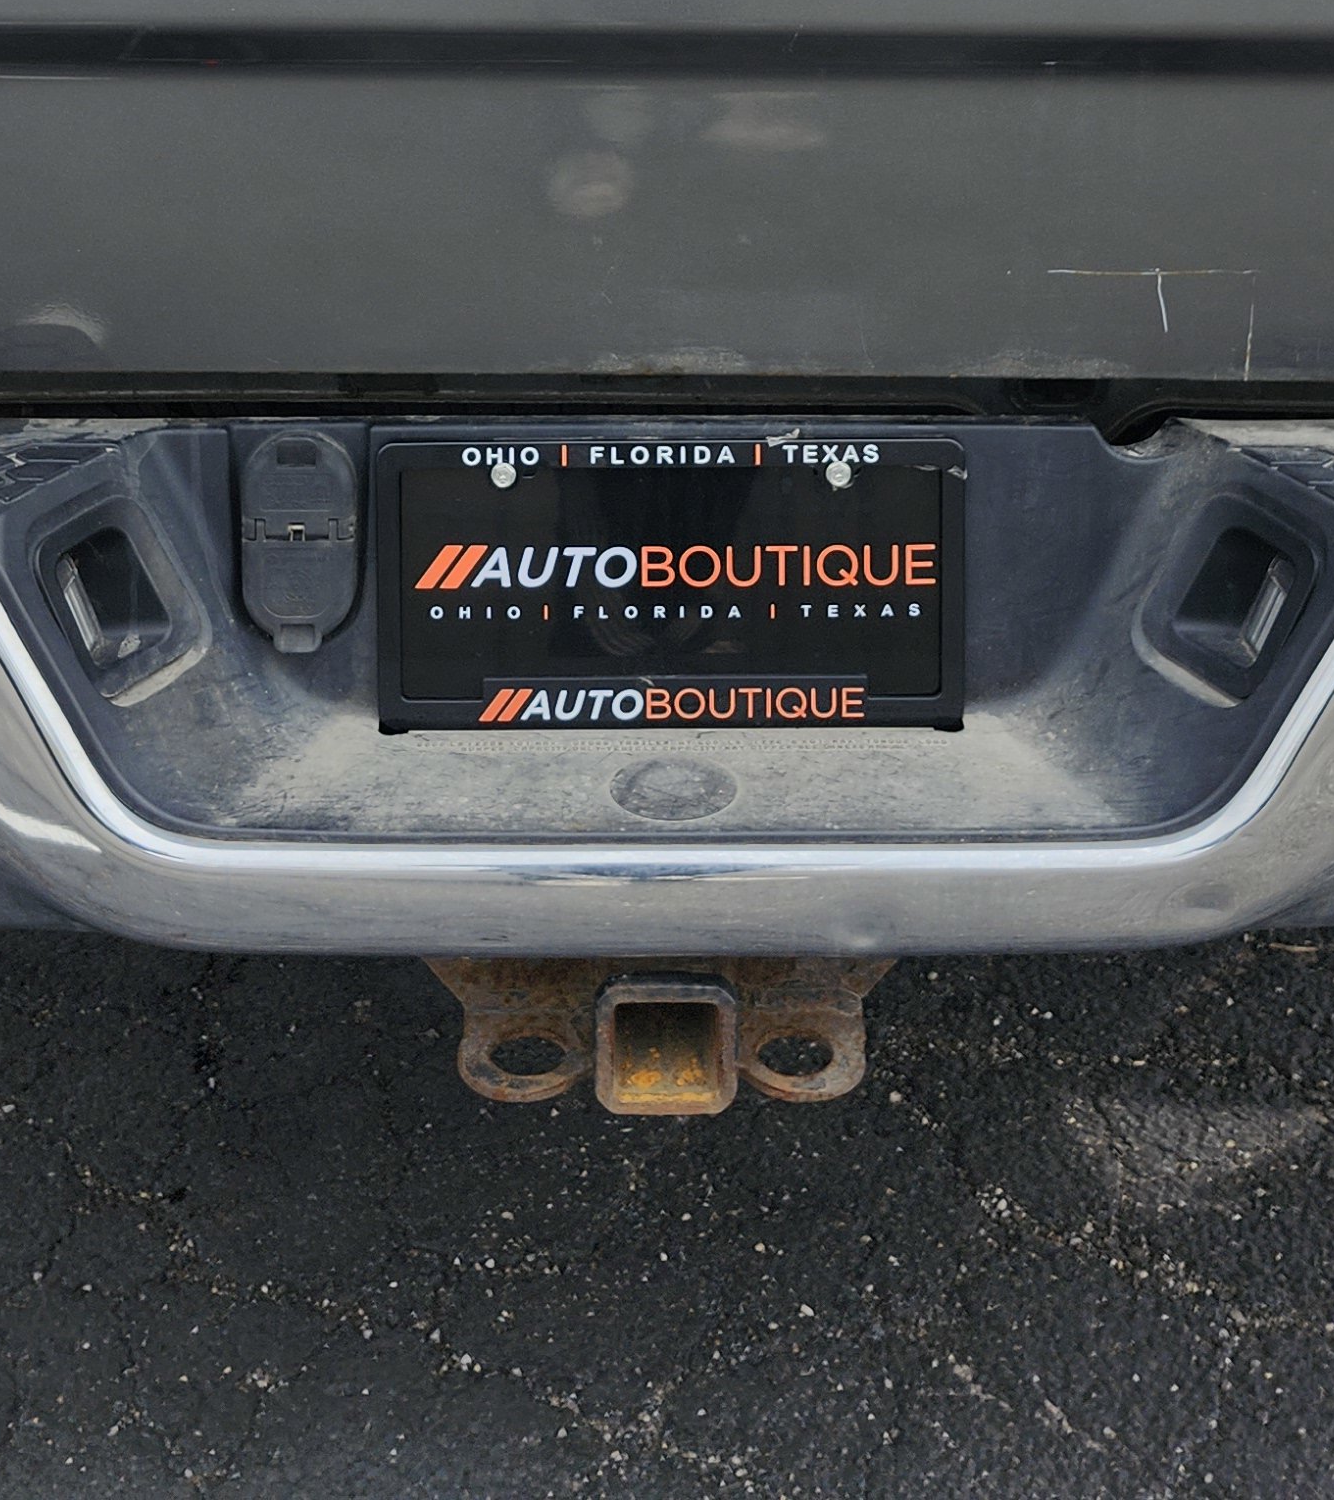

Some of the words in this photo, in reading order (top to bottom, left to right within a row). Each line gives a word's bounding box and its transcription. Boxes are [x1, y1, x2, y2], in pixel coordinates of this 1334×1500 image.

[461, 446, 540, 467] OHIO
[589, 445, 736, 465] FLORIDA
[782, 443, 880, 464] TEXAS
[470, 544, 937, 588] AUTOBOUTIQUE
[430, 605, 521, 620] OHIO
[573, 604, 742, 620] FLORIDA
[800, 603, 922, 619] TEXAS
[520, 687, 866, 721] AUTOBOUTIQUE
